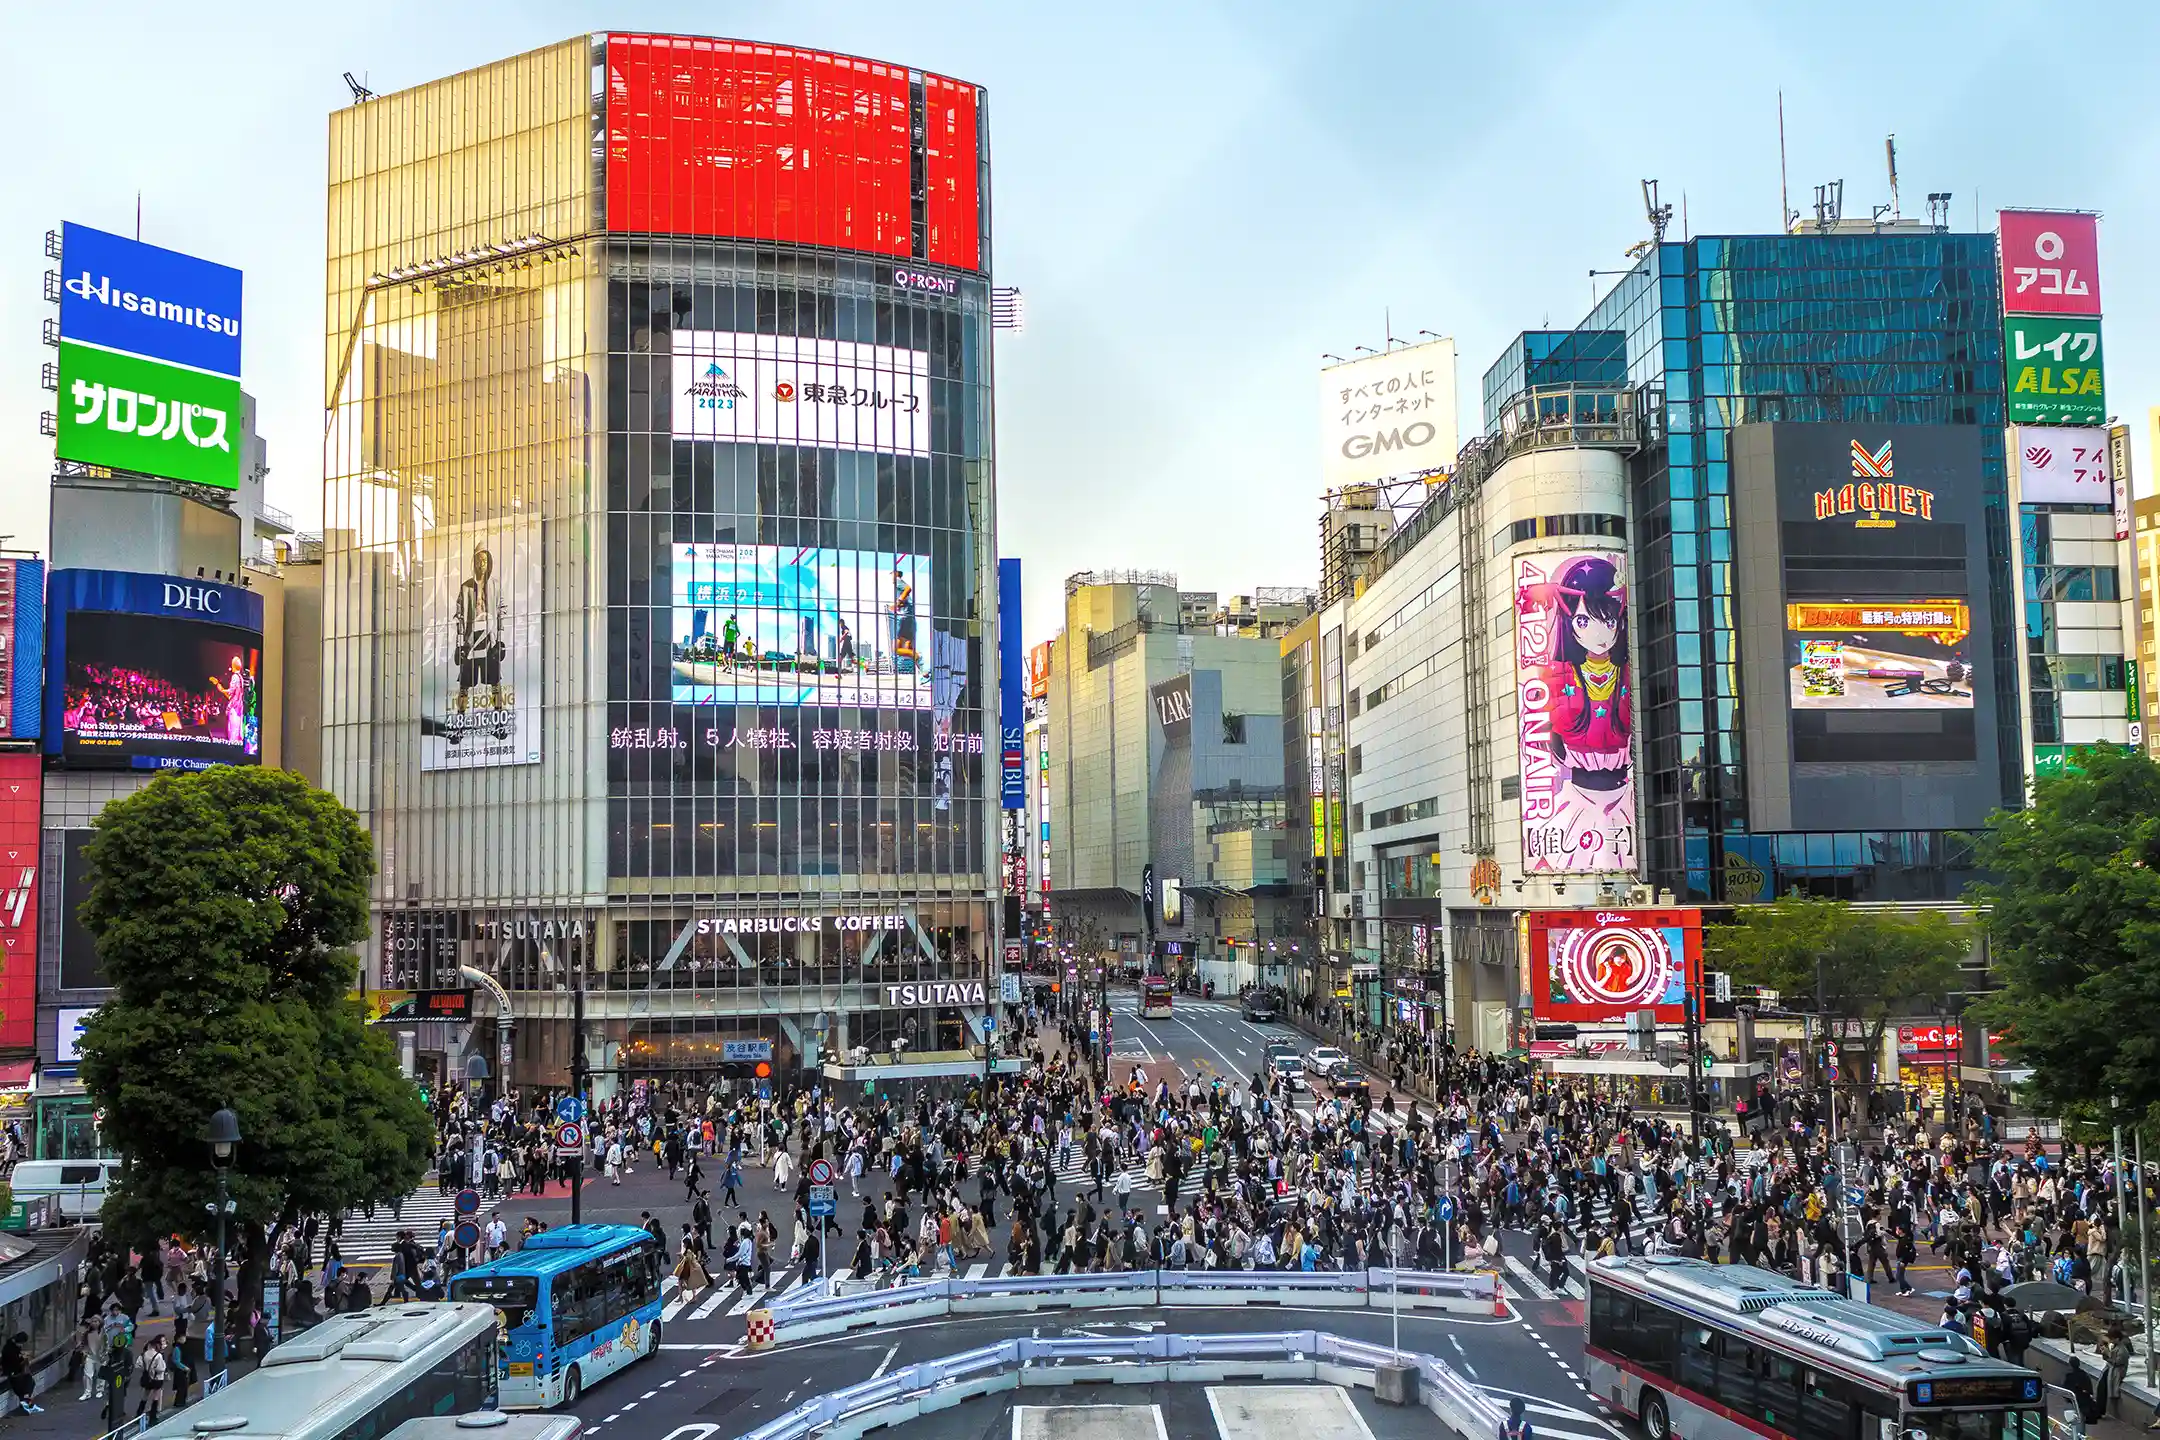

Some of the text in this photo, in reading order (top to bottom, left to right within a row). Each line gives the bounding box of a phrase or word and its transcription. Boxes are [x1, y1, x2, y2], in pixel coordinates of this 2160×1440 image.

[894, 269, 956, 293] QFRONT
[2013, 267, 2089, 295] アコム
[65, 271, 239, 337] Hisamitsu
[2014, 330, 2098, 362] レイク
[684, 387, 748, 399] MARATHON
[1340, 370, 1434, 404] すべての人に
[2014, 366, 2103, 396] ALSA
[71, 379, 230, 453] サロンパス
[699, 398, 733, 409] 2023
[1341, 392, 1435, 426] インターネット
[1341, 421, 1436, 459] GMO
[2072, 448, 2104, 464] アイ
[2073, 469, 2106, 484] フル
[1815, 483, 1934, 521] MAGNET
[163, 583, 221, 614] DHC
[79, 721, 146, 732] Non Stop Rabbit
[107, 739, 124, 747] sale
[610, 727, 690, 750] 銃乱射。
[933, 732, 984, 754] 犯行前
[1521, 678, 1554, 820] ONAIR
[161, 758, 182, 768] DHC
[2035, 754, 2063, 765] レイク
[1526, 824, 1634, 857] 【推しの子】
[488, 920, 584, 941] TSUTAYA
[697, 914, 905, 935] STARBUCKS COFFEE
[1596, 912, 1632, 927] Glico
[1007, 948, 1019, 960] 本
[886, 982, 986, 1006] TSUTAYA
[1777, 1319, 1841, 1349] Hybrid
